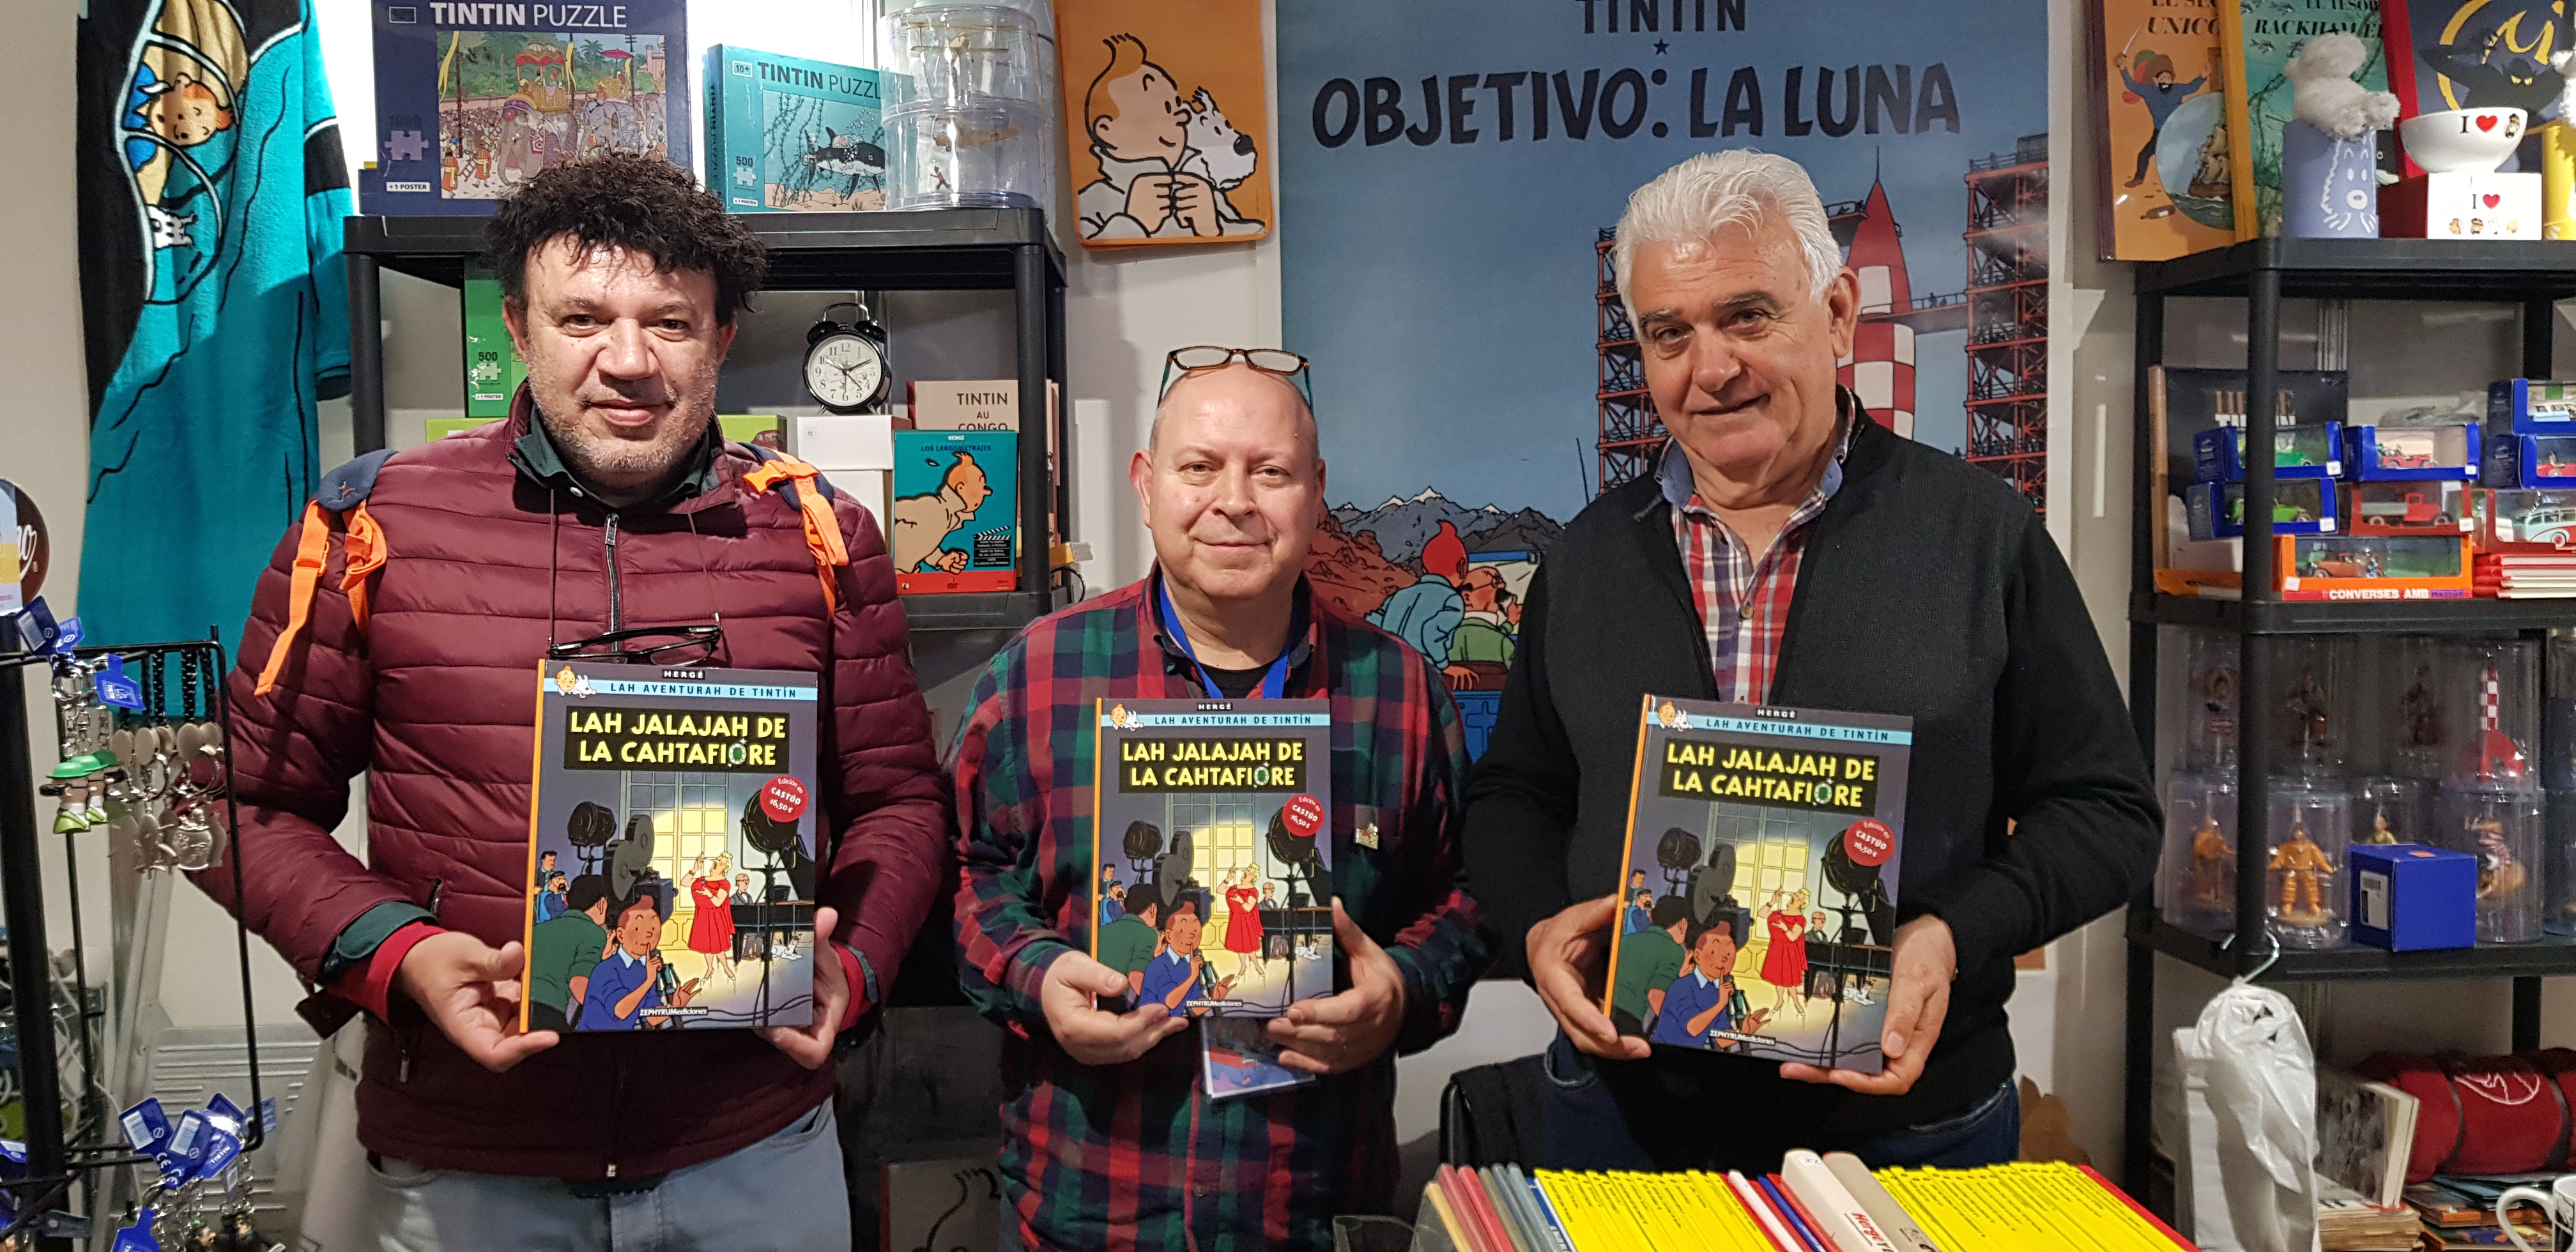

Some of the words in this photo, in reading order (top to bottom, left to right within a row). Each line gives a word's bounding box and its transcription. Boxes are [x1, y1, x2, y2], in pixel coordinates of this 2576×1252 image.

[430, 3, 525, 26] TINTIN
[533, 4, 627, 27] PUZZLE
[736, 65, 750, 73] 10+
[758, 61, 823, 89] TINTIN
[829, 75, 880, 100] PUZZL
[1312, 68, 1668, 148] OBJETIVO:
[1689, 66, 1764, 139] LA
[1784, 62, 1960, 139] LUNA
[2460, 116, 2469, 133] I
[736, 156, 753, 166] 500
[2471, 194, 2477, 210] I
[829, 346, 837, 356] 11
[841, 342, 850, 352] 12
[479, 352, 498, 361] 500
[815, 367, 821, 377] 9
[820, 379, 826, 389] 8
[831, 389, 836, 399] 7
[843, 392, 848, 402] 6
[957, 393, 1008, 405] TINTIN
[2329, 588, 2399, 600] CONVERSES
[2404, 588, 2428, 599] AMB
[664, 670, 703, 679] HERGÉ
[611, 683, 635, 692] LAH
[643, 684, 721, 695] AVENTURAH
[730, 687, 745, 696] DE
[753, 686, 795, 698] TINTÍN
[1155, 716, 1175, 724] LAH
[1182, 716, 1246, 724] AVENTURAH
[1273, 714, 1310, 724] TINTÍN
[1757, 708, 1796, 719] HERGÉ
[571, 712, 622, 733] LAH
[631, 714, 747, 737] JALAJAH
[758, 717, 785, 738] DE
[1706, 719, 1728, 728] LAH
[1736, 722, 1811, 735] AVENTURAH
[1821, 728, 1836, 737] DE
[1844, 729, 1888, 741] TINTÍN
[580, 740, 613, 761] LA
[621, 742, 776, 766] CAHTAFIORE
[1124, 743, 1165, 761] LAH
[1172, 743, 1270, 761] JALAJAH
[1278, 743, 1303, 761] DE
[1667, 743, 1715, 767] LAH
[1722, 749, 1836, 777] JALAJAH
[1845, 758, 1874, 781] DE
[778, 778, 798, 788] Edición
[1131, 767, 1158, 786] LA
[1165, 767, 1294, 786] CAHTAFIORE
[771, 787, 801, 805] CASTÚO
[1673, 770, 1703, 792] LA
[1711, 774, 1863, 807] CAHTAFIORE
[1292, 804, 1318, 821] CASTÚO
[1856, 830, 1887, 850] CASTÚO
[210, 1145, 231, 1164] TINTIN
